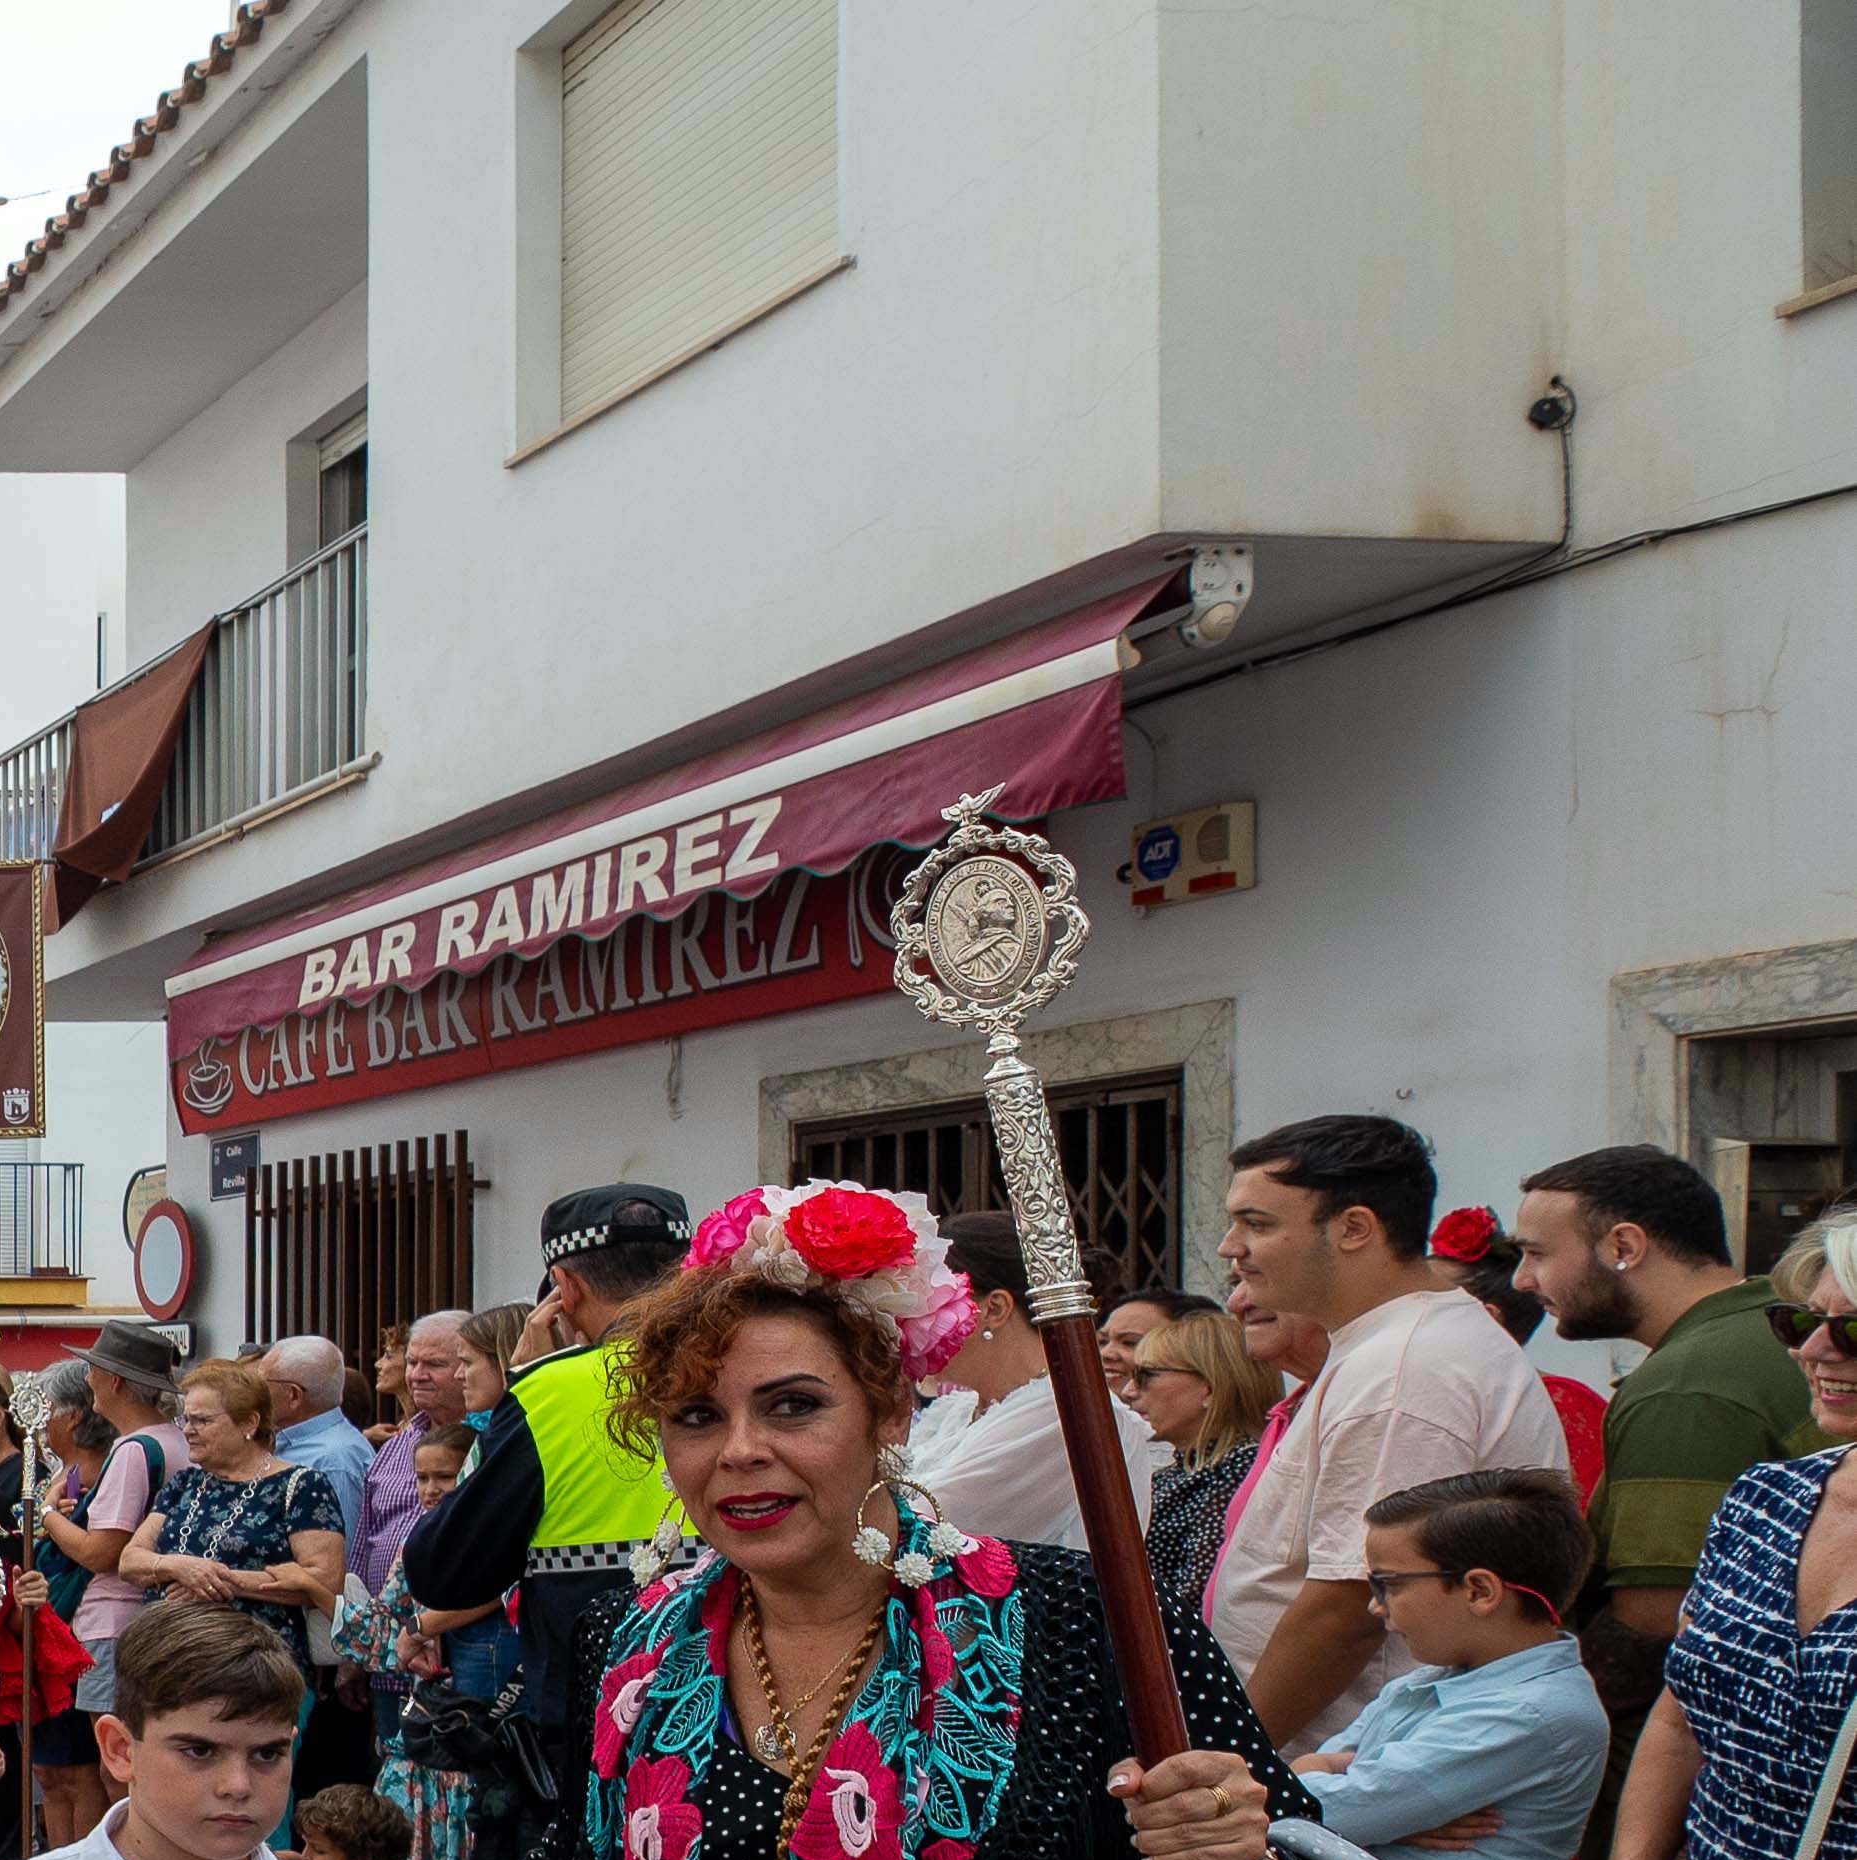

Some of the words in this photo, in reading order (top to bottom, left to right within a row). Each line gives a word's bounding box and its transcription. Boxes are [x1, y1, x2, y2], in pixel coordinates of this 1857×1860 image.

[297, 920, 417, 1008] BAR
[434, 795, 783, 969] RAMIREZ
[1143, 838, 1175, 863] ADT
[367, 971, 477, 1069] BAR
[490, 873, 821, 1038] RAMIREZ
[225, 1145, 243, 1158] Calle
